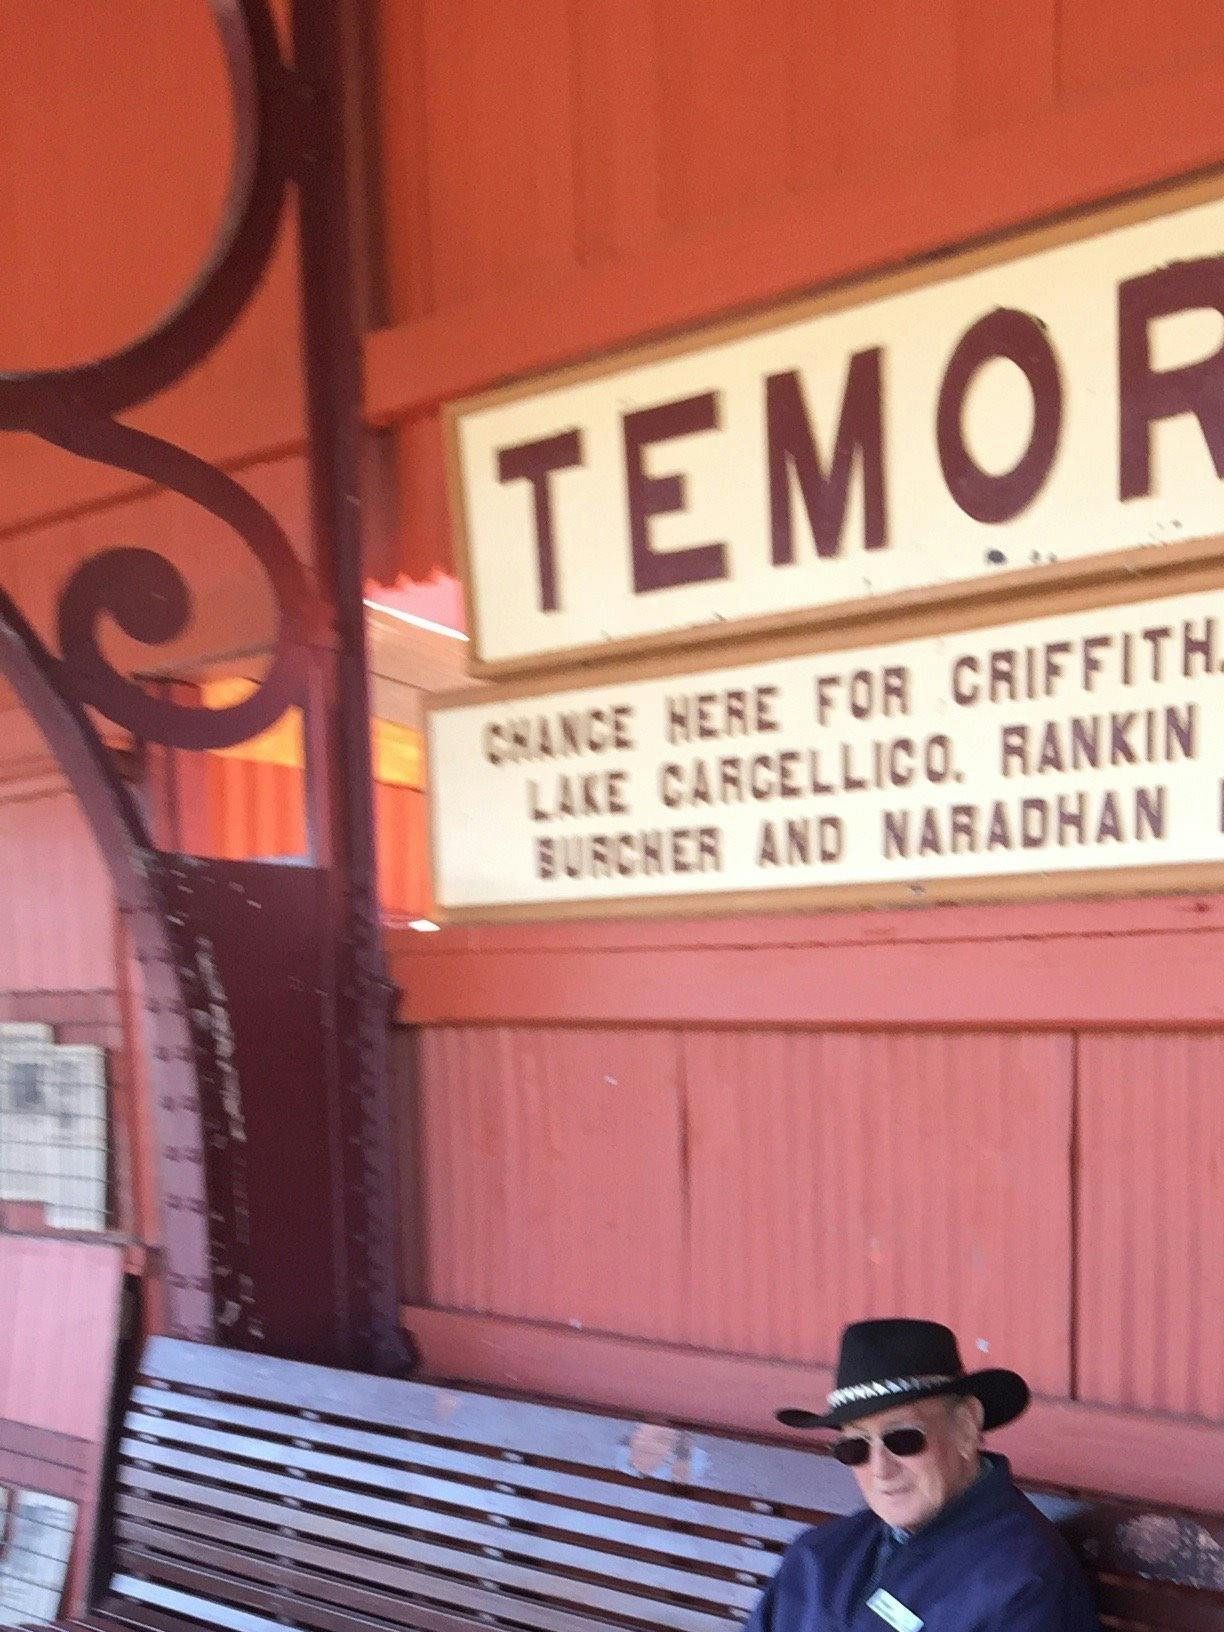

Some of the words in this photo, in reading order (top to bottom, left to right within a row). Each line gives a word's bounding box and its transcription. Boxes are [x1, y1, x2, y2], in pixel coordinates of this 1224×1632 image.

[665, 685, 780, 744] HERE
[815, 665, 911, 727] FOR
[529, 769, 629, 823] LAKE
[1001, 703, 1198, 778] RANKIN
[535, 827, 722, 881] BURCHER
[757, 815, 843, 868] AND
[882, 785, 1167, 860] NARADHAN
